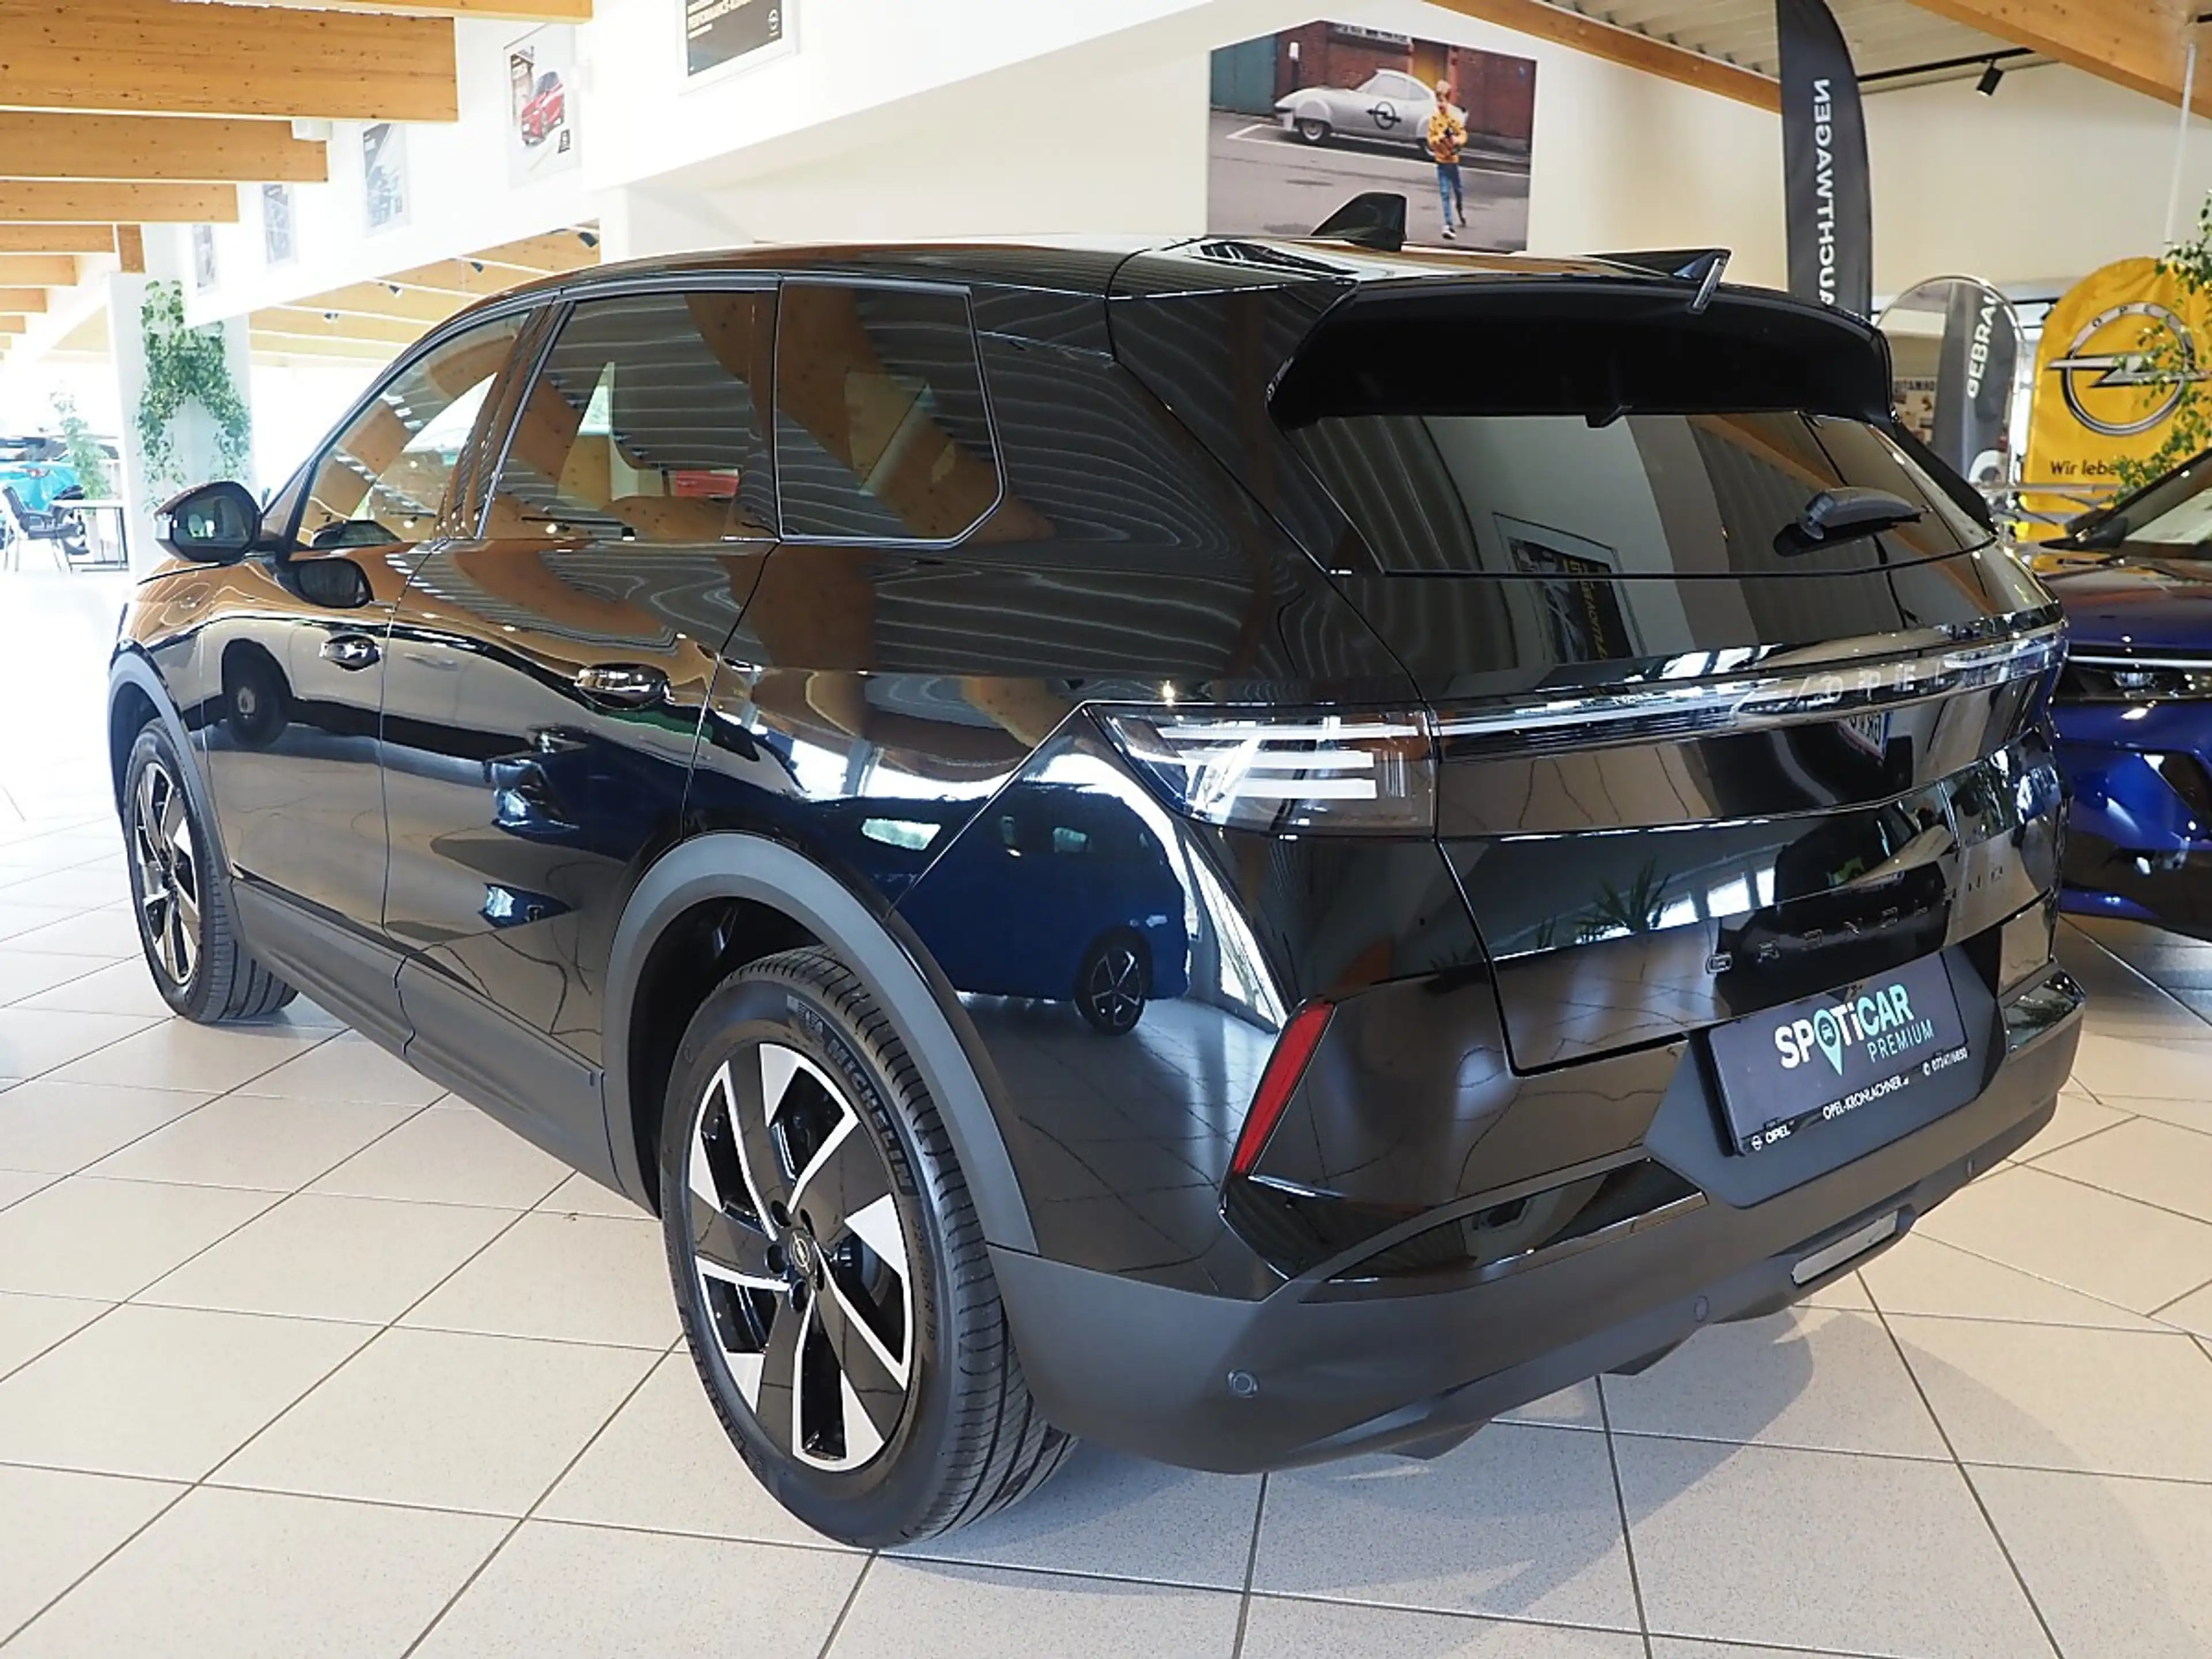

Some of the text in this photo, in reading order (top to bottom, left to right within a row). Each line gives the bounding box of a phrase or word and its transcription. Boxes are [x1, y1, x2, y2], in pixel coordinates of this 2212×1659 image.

[2050, 460, 2077, 476] Wir
[1866, 1018, 1935, 1063] PREMIUM
[827, 1038, 917, 1190] MICHELIN
[1765, 1124, 1791, 1144] OPEL
